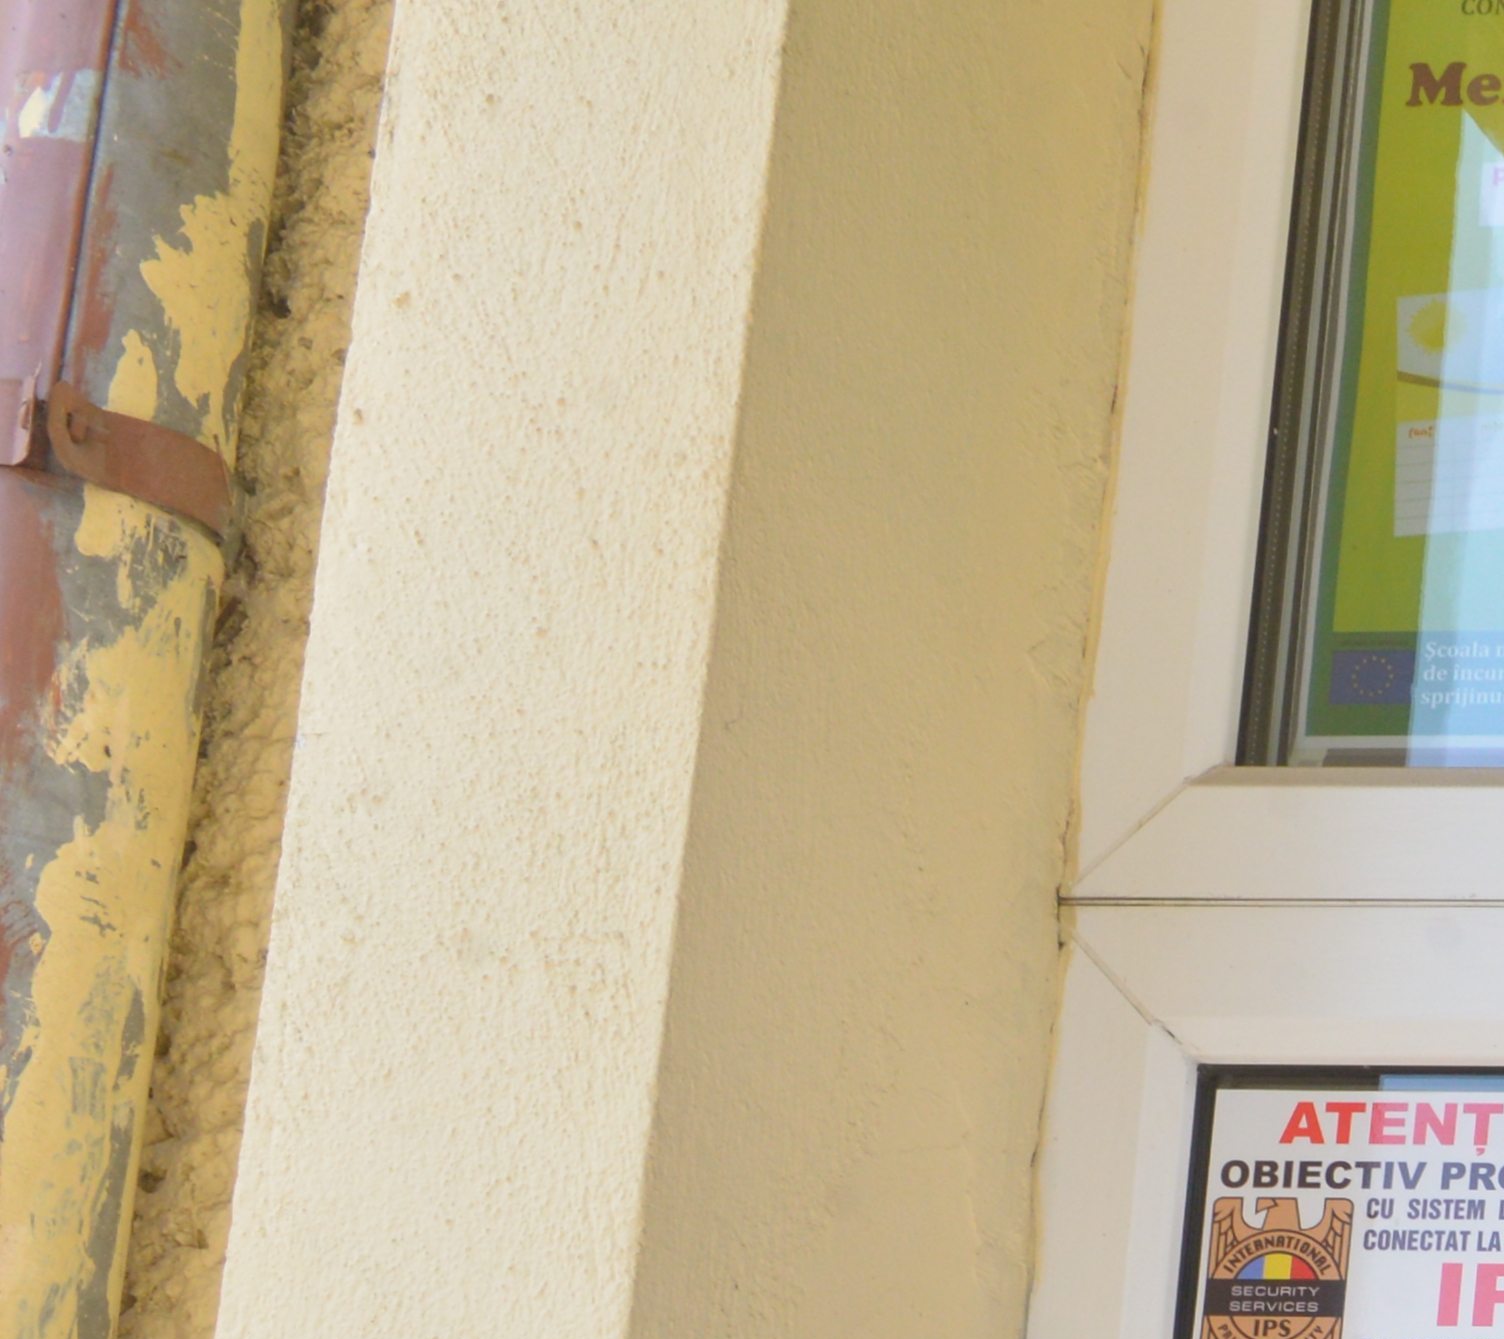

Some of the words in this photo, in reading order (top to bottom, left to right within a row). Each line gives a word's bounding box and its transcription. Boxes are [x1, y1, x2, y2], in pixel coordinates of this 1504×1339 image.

[1423, 665, 1448, 681] de
[1220, 1160, 1428, 1190] OBIECTIV
[1366, 1198, 1395, 1219] CU
[1407, 1198, 1486, 1221] SISTEM
[1363, 1229, 1471, 1252] CONECTAT
[1476, 1231, 1502, 1252] LA
[1223, 1235, 1332, 1276] INTERNATIONAL
[1231, 1286, 1320, 1297] SECURITY
[1229, 1301, 1319, 1313] SERVICES
[1253, 1318, 1292, 1338] IPS
